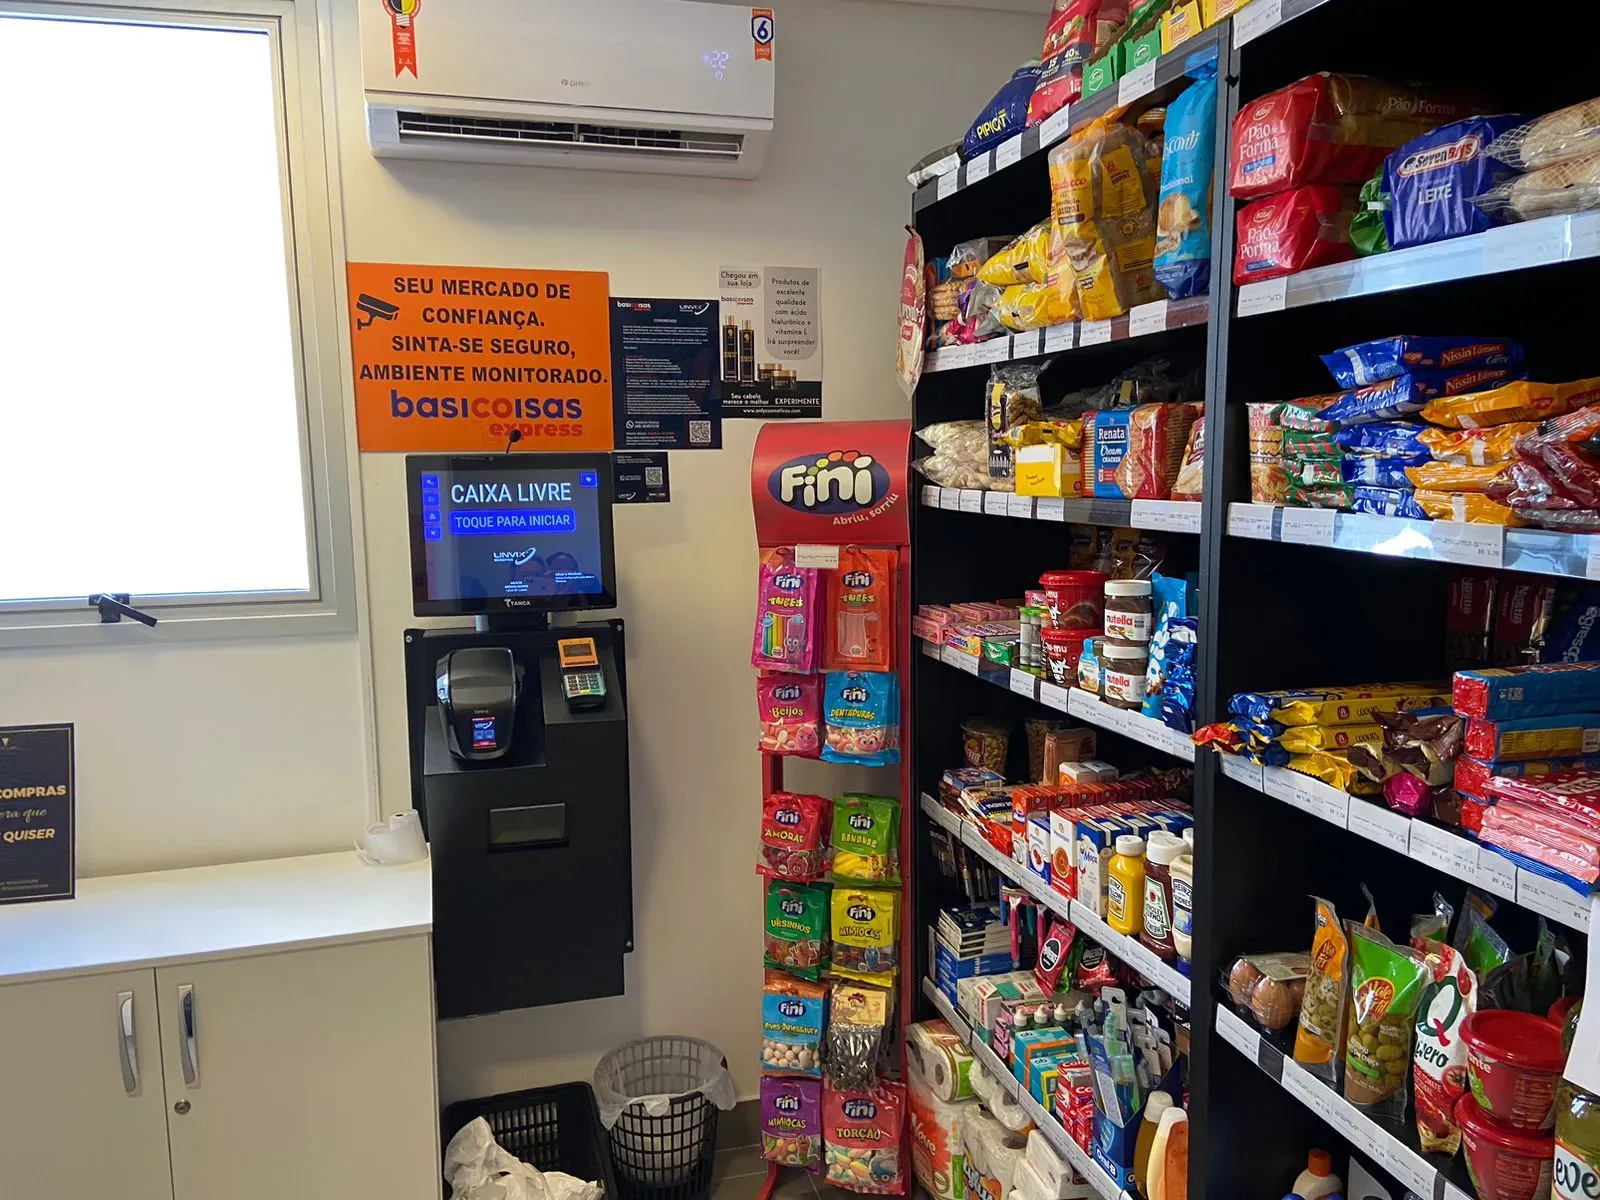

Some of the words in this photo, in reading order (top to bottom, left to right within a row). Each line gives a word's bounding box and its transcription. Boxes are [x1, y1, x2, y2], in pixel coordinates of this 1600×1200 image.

[757, 20, 768, 40] 6
[1247, 123, 1271, 143] Pão
[1239, 136, 1280, 161] Forma
[721, 271, 746, 281] Chegou
[740, 280, 752, 288] loja
[771, 278, 800, 286] Produtos
[802, 279, 810, 287] de
[393, 277, 433, 294] SEU
[441, 278, 539, 299] MERCADO
[546, 283, 570, 299] DE
[775, 298, 806, 307] qualidade
[421, 307, 545, 330] CONFIANÇA.
[775, 328, 802, 336] vitamina
[391, 335, 484, 354] SINTA-SE
[490, 338, 575, 359] SEGURO,
[778, 339, 815, 347] surpreender
[1442, 348, 1472, 366] Nissin
[359, 364, 465, 382] AMBIENTE
[472, 366, 608, 384] MONITORADO.
[1446, 374, 1476, 393] Nissin
[390, 389, 583, 419] basicoisas
[775, 397, 821, 406] EXPERIMENTE
[489, 421, 583, 442] express
[1098, 428, 1125, 440] Renata
[1101, 445, 1122, 456] Cream
[780, 455, 872, 507] Fini
[451, 483, 512, 503] CAIXA
[517, 482, 572, 502] LIVRE
[833, 513, 869, 526] Abriu,
[869, 492, 900, 519] sorriu
[455, 516, 494, 529] TOQUE
[497, 515, 526, 528] PARA
[529, 514, 570, 526] INICIAR
[775, 573, 802, 590] Fini
[844, 571, 870, 588] Fini
[767, 596, 804, 609] TUBES
[840, 593, 875, 604] TUBES
[1106, 614, 1133, 627] nutella
[1106, 674, 1130, 688] nutella
[775, 684, 800, 700] Fini
[842, 687, 866, 703] Fini
[772, 706, 804, 719] Beijos
[830, 708, 876, 721] DENTADURAS
[22, 809, 48, 823] que
[775, 808, 800, 825] Fini
[849, 815, 872, 832] Fini
[3, 828, 56, 844] QUISER
[764, 828, 804, 843] AMORAS
[781, 900, 804, 915] Fini
[850, 906, 873, 921] Fini
[770, 918, 811, 934] URSINHOS
[839, 927, 881, 940] MINHOCAS
[780, 1000, 804, 1016] Fini
[1062, 1059, 1089, 1069] Colg
[775, 1096, 799, 1111] Fini
[845, 1100, 875, 1118] Fini
[768, 1118, 806, 1129] MINHOCAS
[1096, 1147, 1117, 1176] Oral-B
